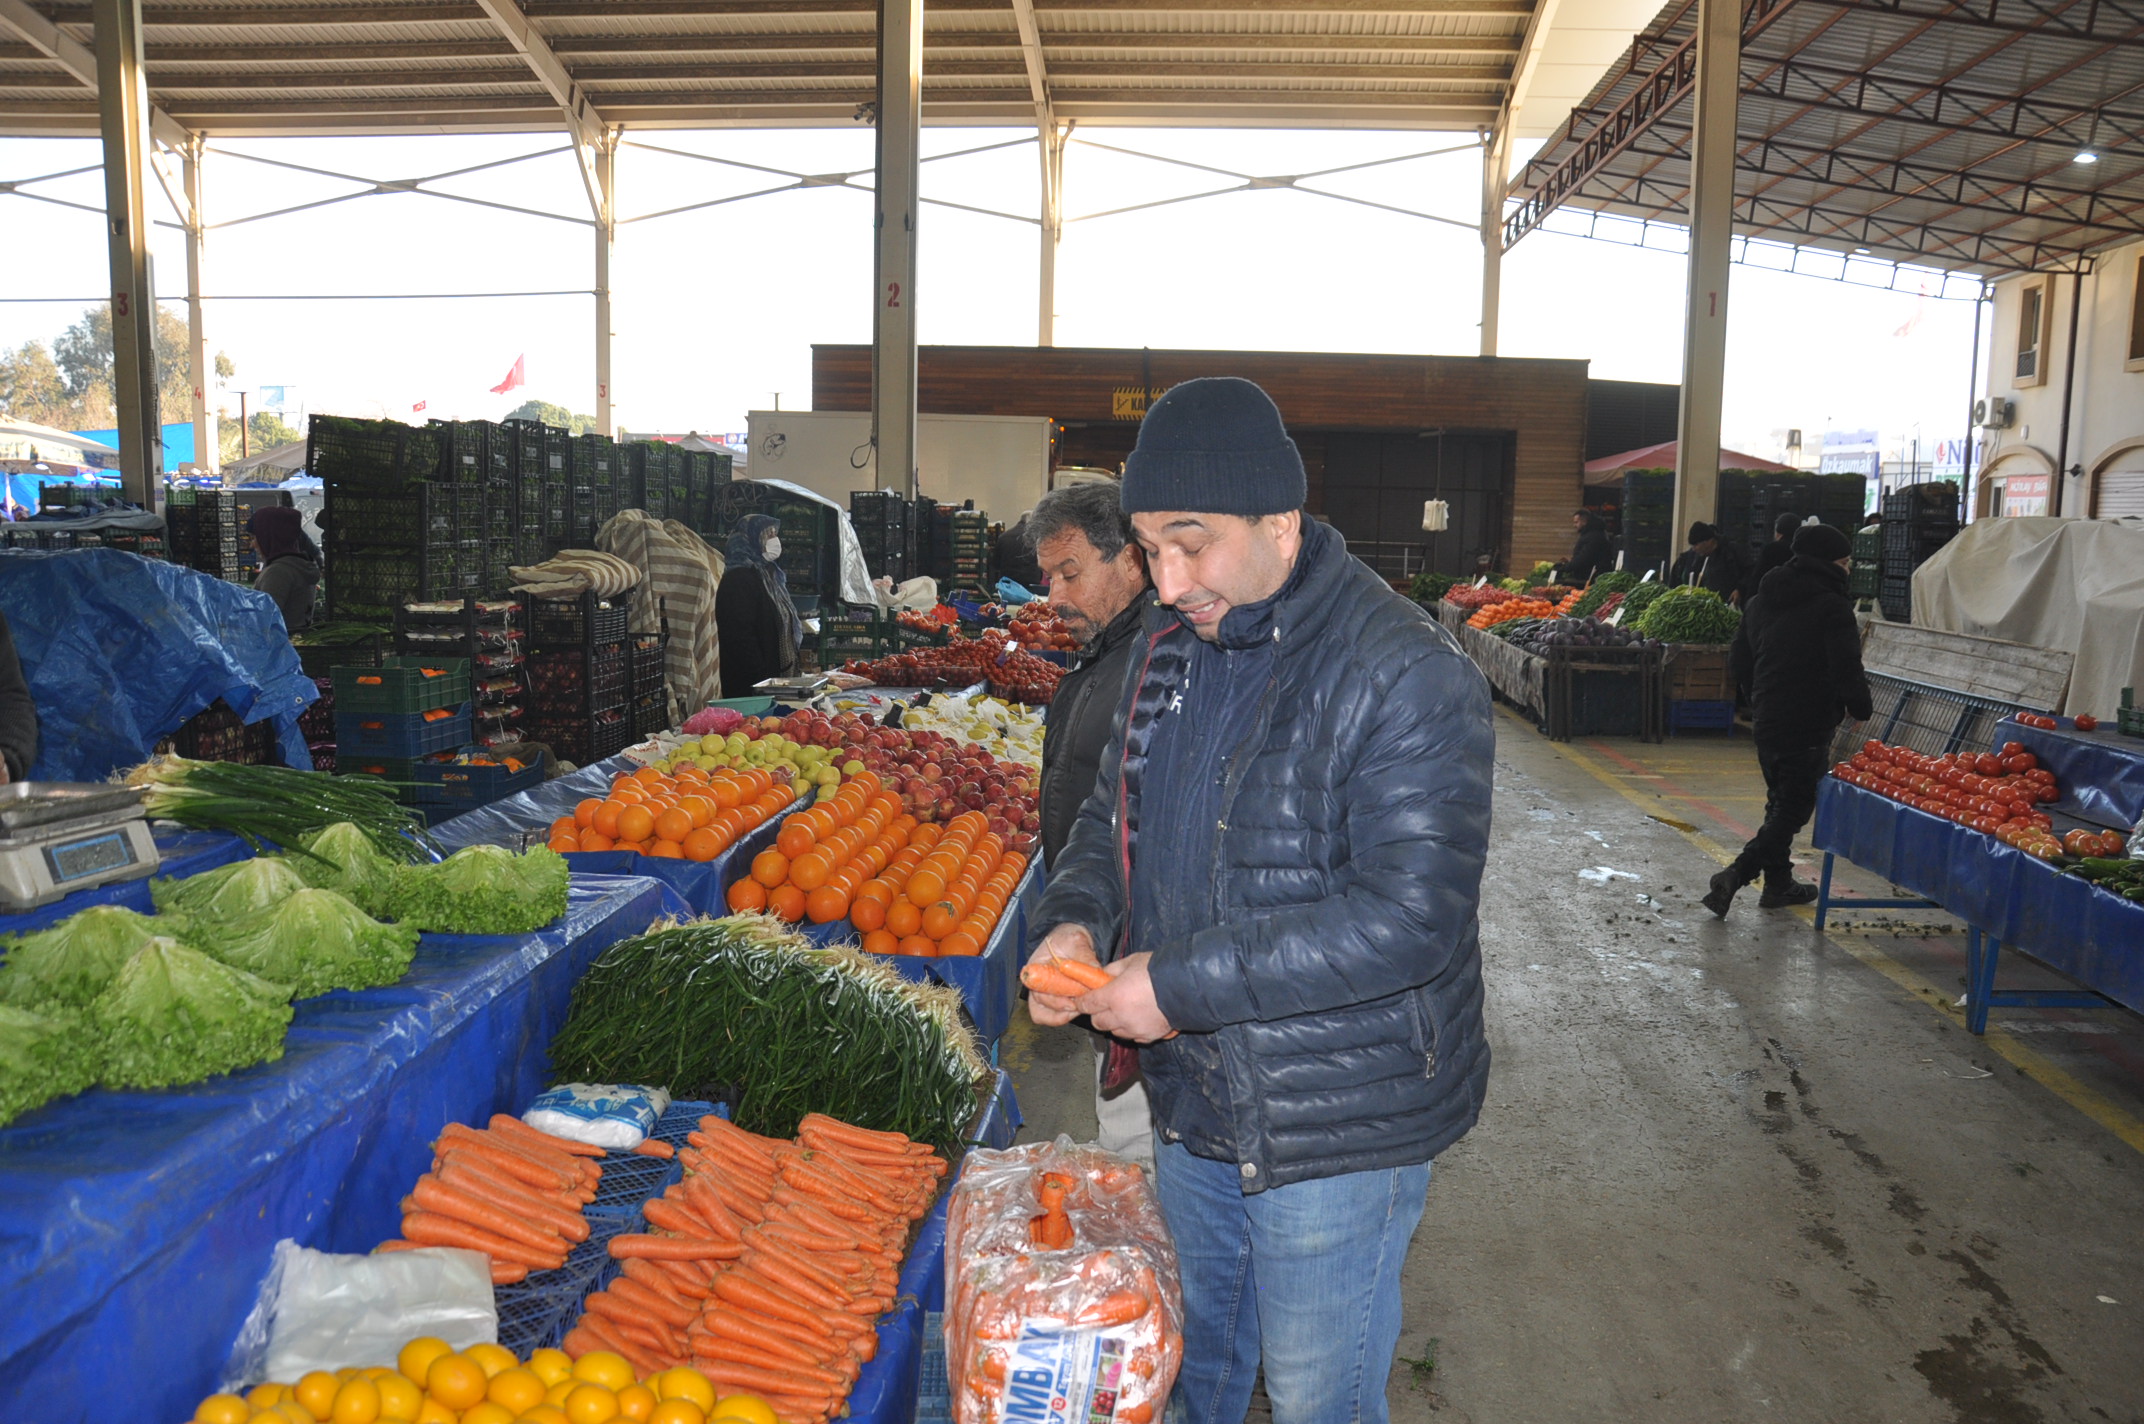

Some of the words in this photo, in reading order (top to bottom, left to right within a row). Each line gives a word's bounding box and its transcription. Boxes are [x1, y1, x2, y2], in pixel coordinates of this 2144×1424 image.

[116, 292, 129, 317] 3
[887, 281, 901, 308] 2
[1708, 291, 1717, 318] 1
[194, 386, 202, 400] 4
[599, 384, 606, 399] 3
